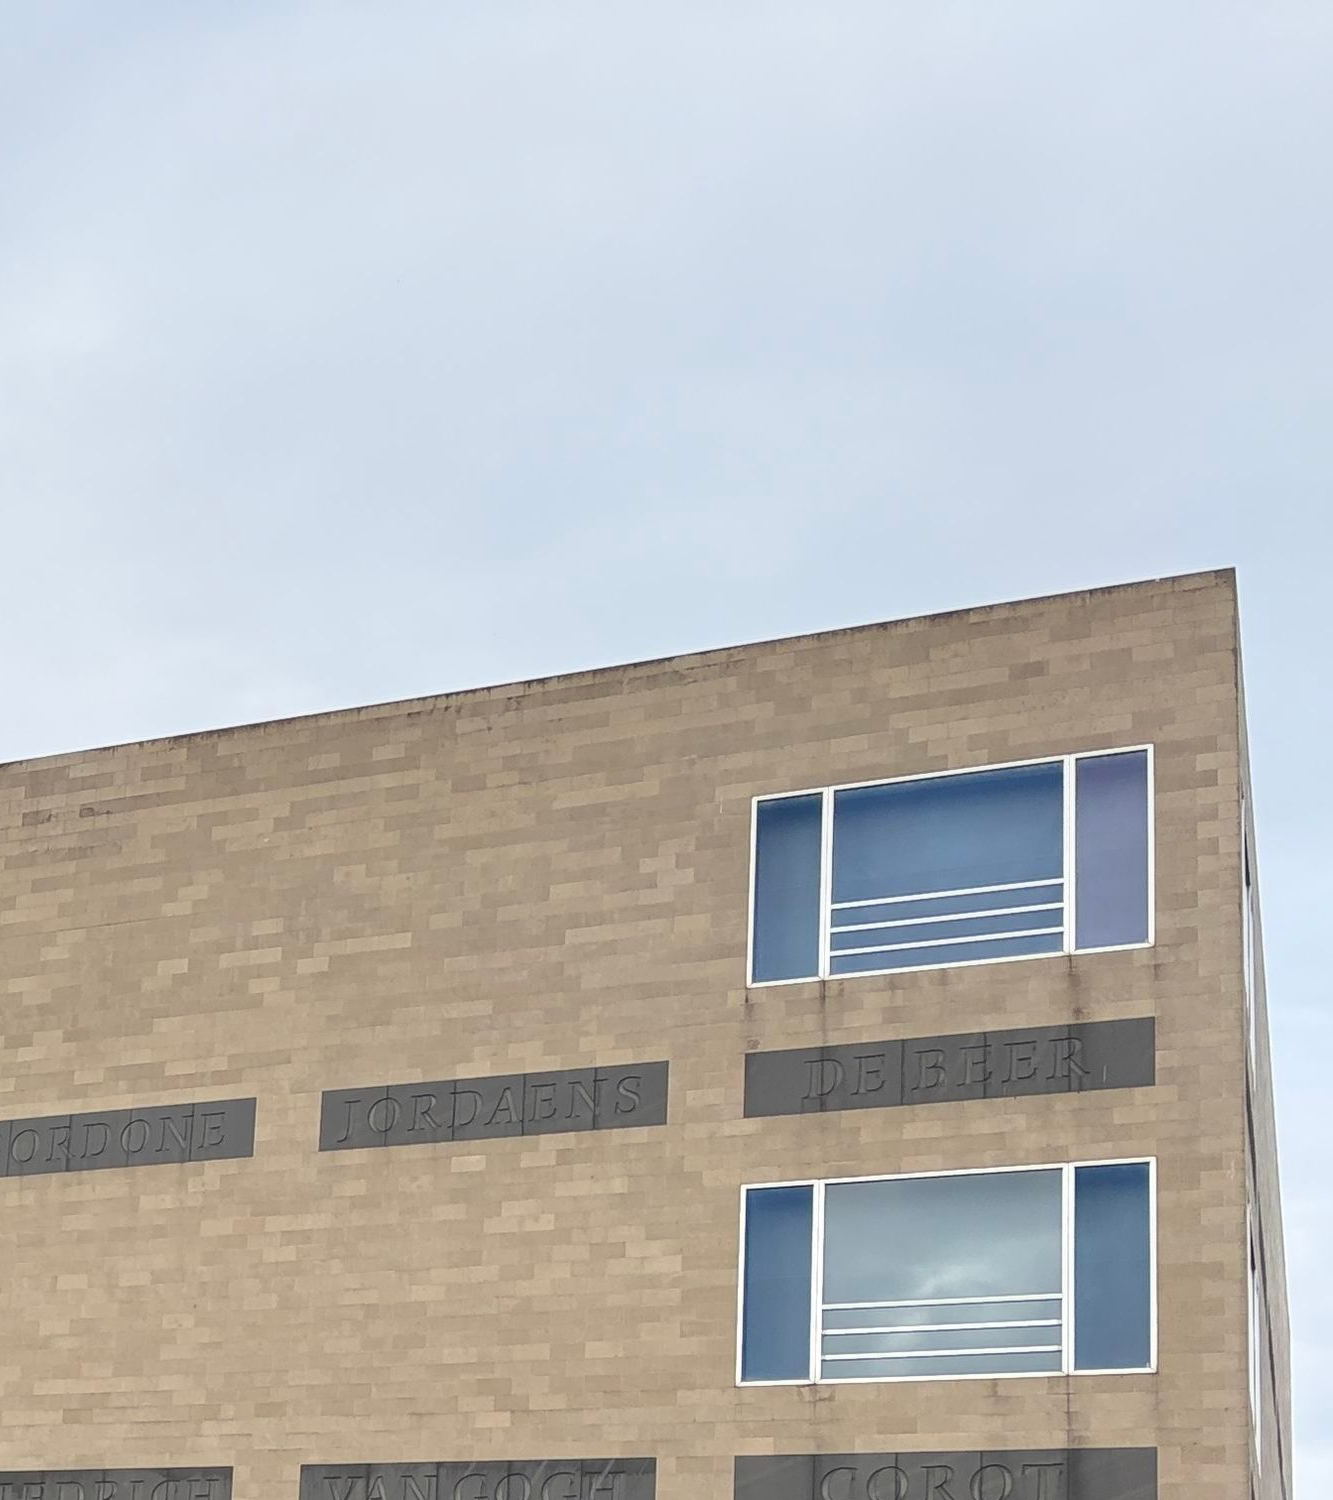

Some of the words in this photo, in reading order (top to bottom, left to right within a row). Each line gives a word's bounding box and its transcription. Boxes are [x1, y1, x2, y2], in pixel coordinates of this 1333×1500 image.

[803, 1052, 886, 1101] DE
[913, 1035, 1091, 1090] BEER
[336, 1075, 642, 1144] JORDAENS
